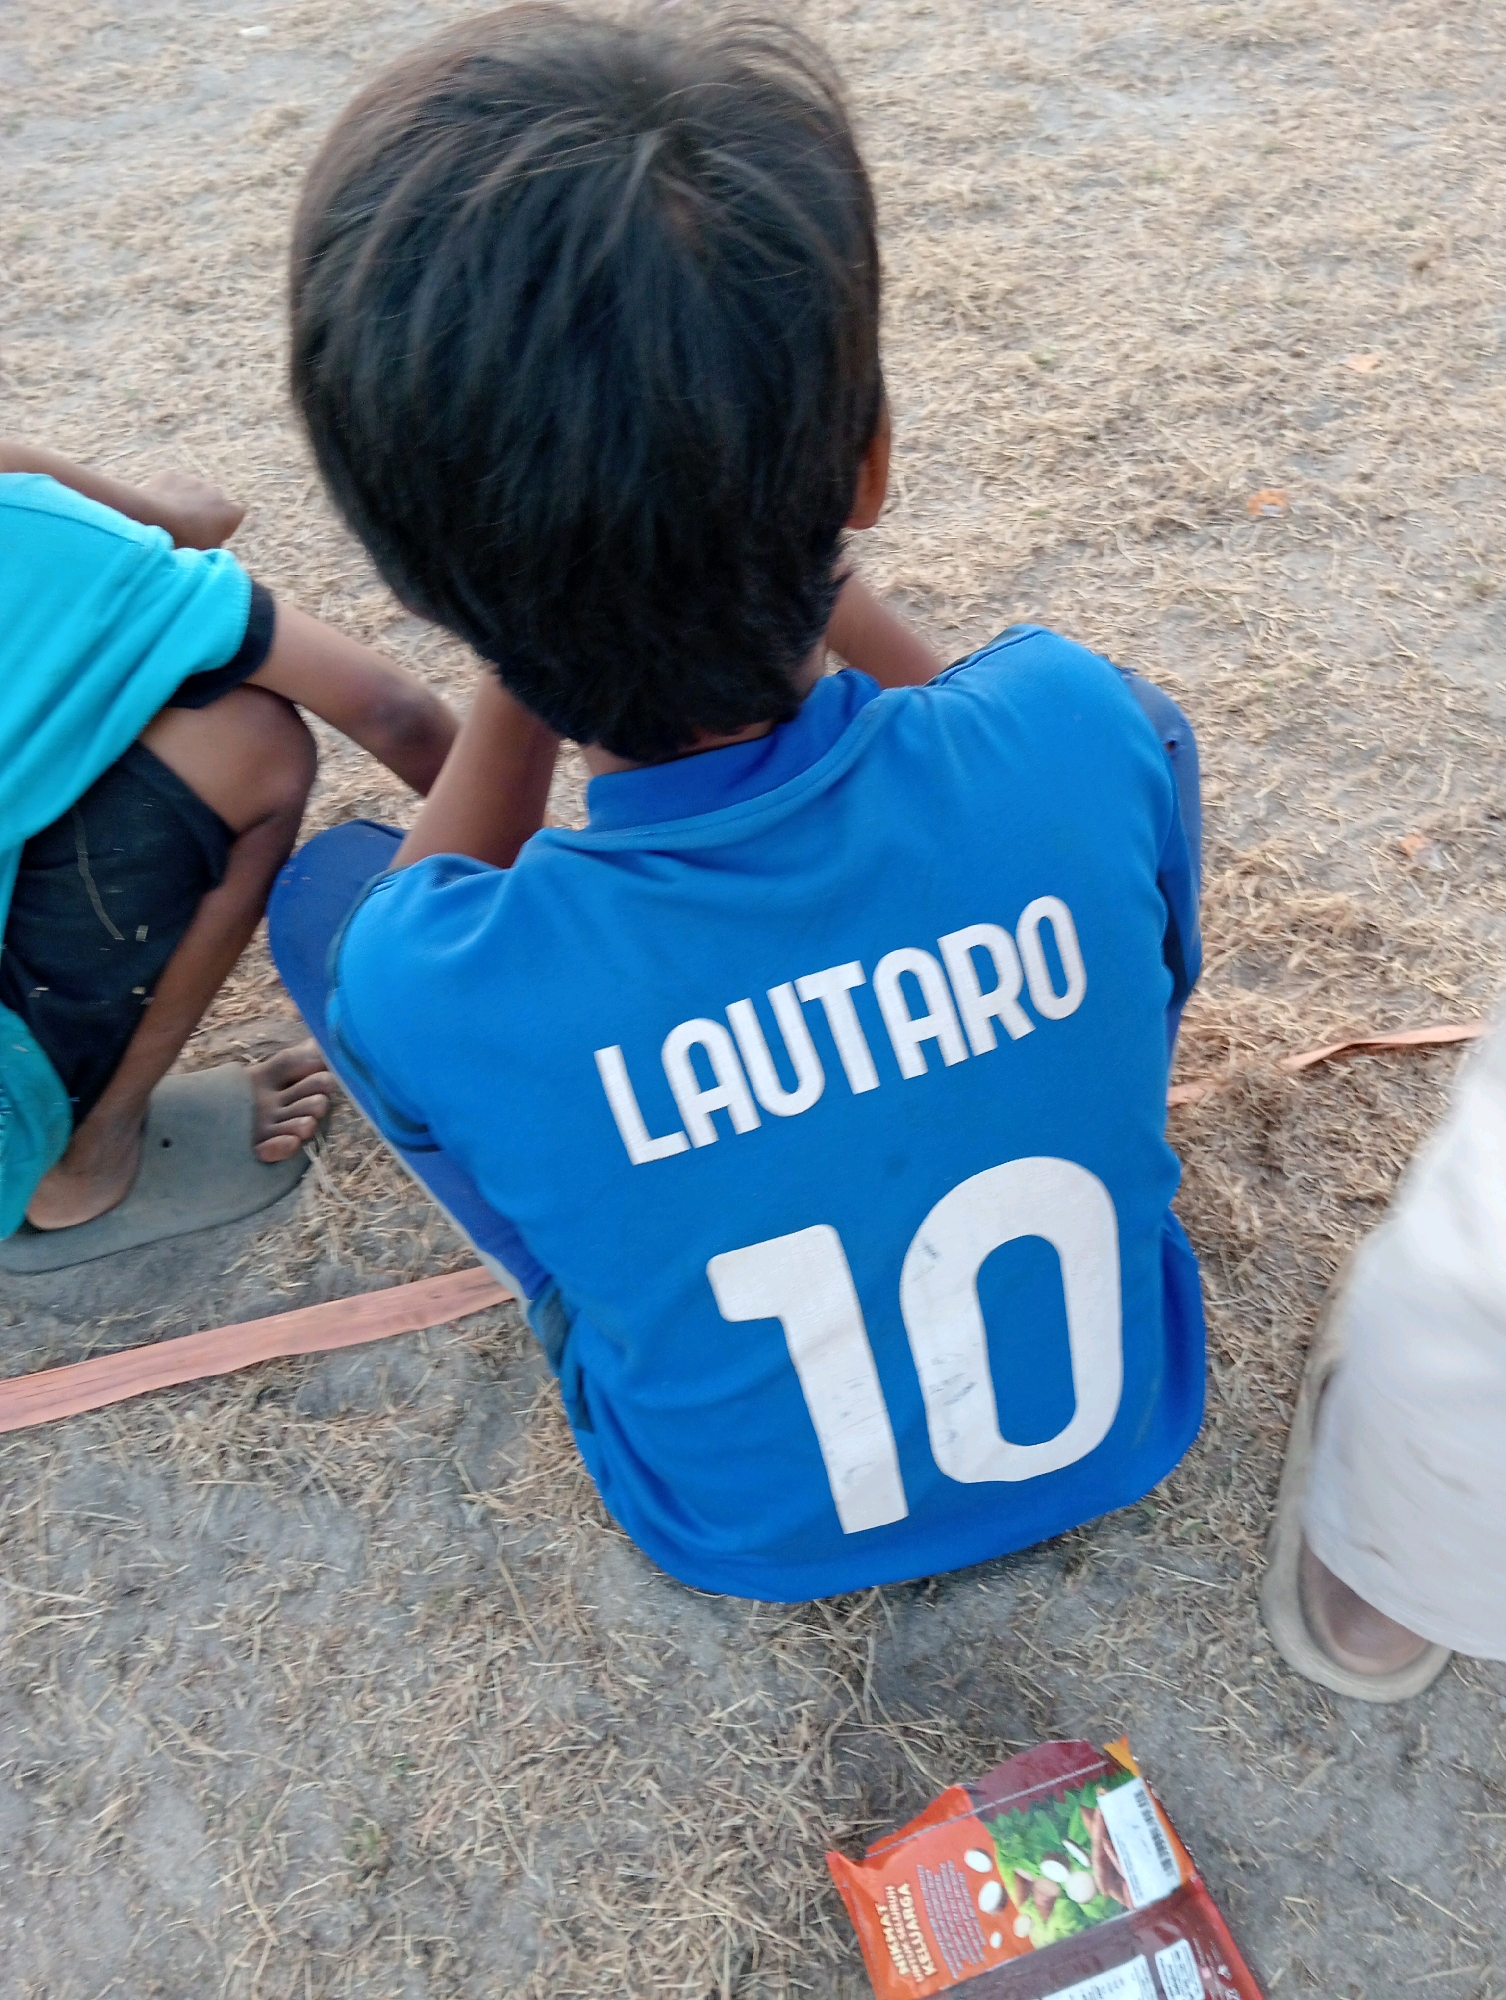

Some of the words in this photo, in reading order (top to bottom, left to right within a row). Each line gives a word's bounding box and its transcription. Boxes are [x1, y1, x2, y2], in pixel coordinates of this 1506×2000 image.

[594, 895, 1087, 1165] LAUTARO
[706, 1156, 1124, 1534] 10
[875, 1903, 911, 1975] NIKMAT
[885, 1886, 907, 1940] SELURUH
[897, 1883, 938, 1976] KELUARGA
[901, 1939, 925, 1983] UNTUK
